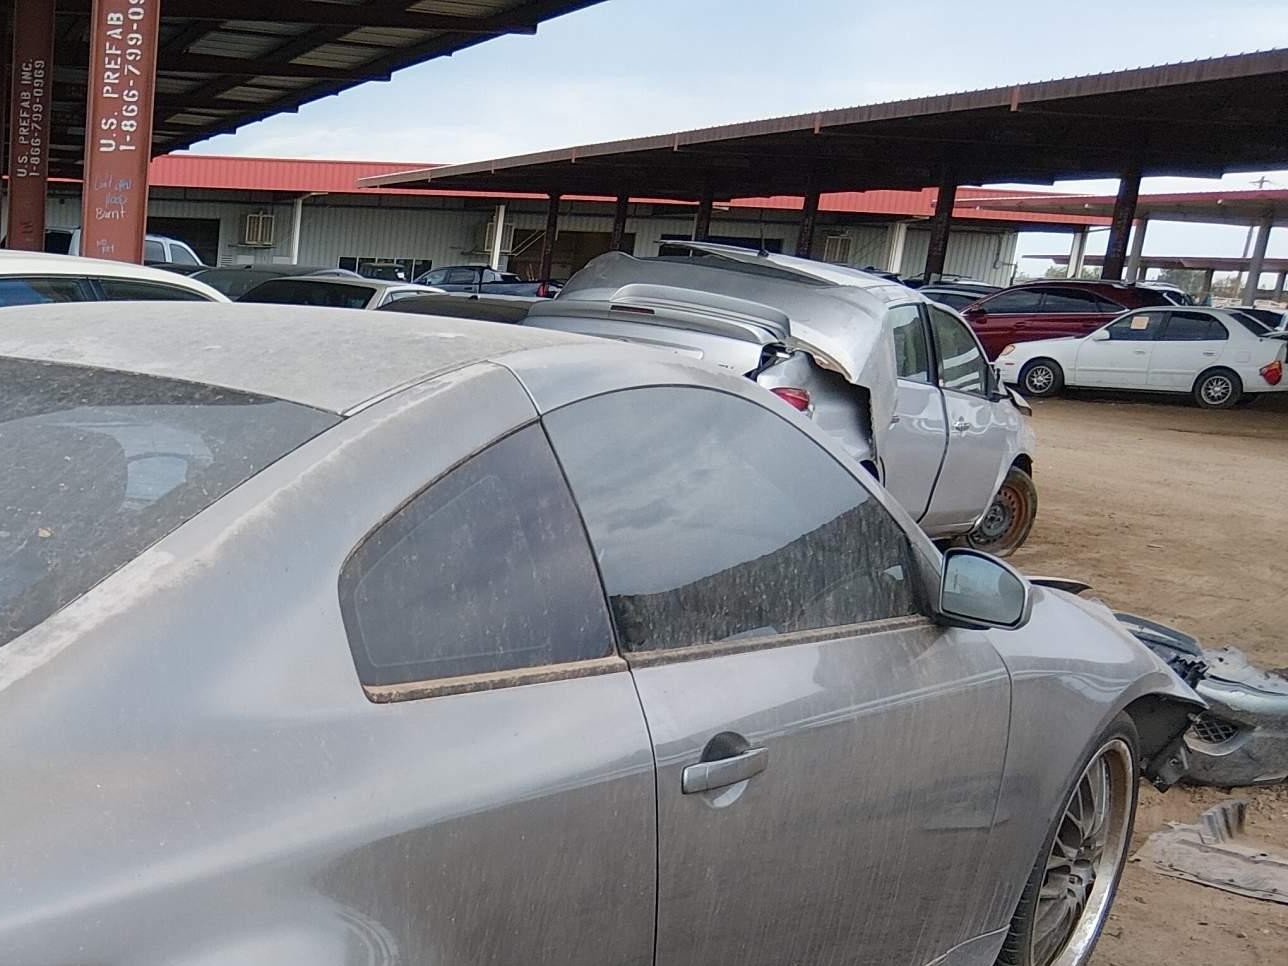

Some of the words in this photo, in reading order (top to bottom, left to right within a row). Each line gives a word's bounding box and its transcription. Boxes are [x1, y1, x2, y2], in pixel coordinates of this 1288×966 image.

[20, 58, 33, 85] INC.
[102, 12, 124, 98] PREFAB
[18, 91, 32, 145] PREFAB
[29, 59, 45, 177] 1-866-799-0969
[99, 111, 118, 152] U.S.
[16, 151, 29, 177] U.S.
